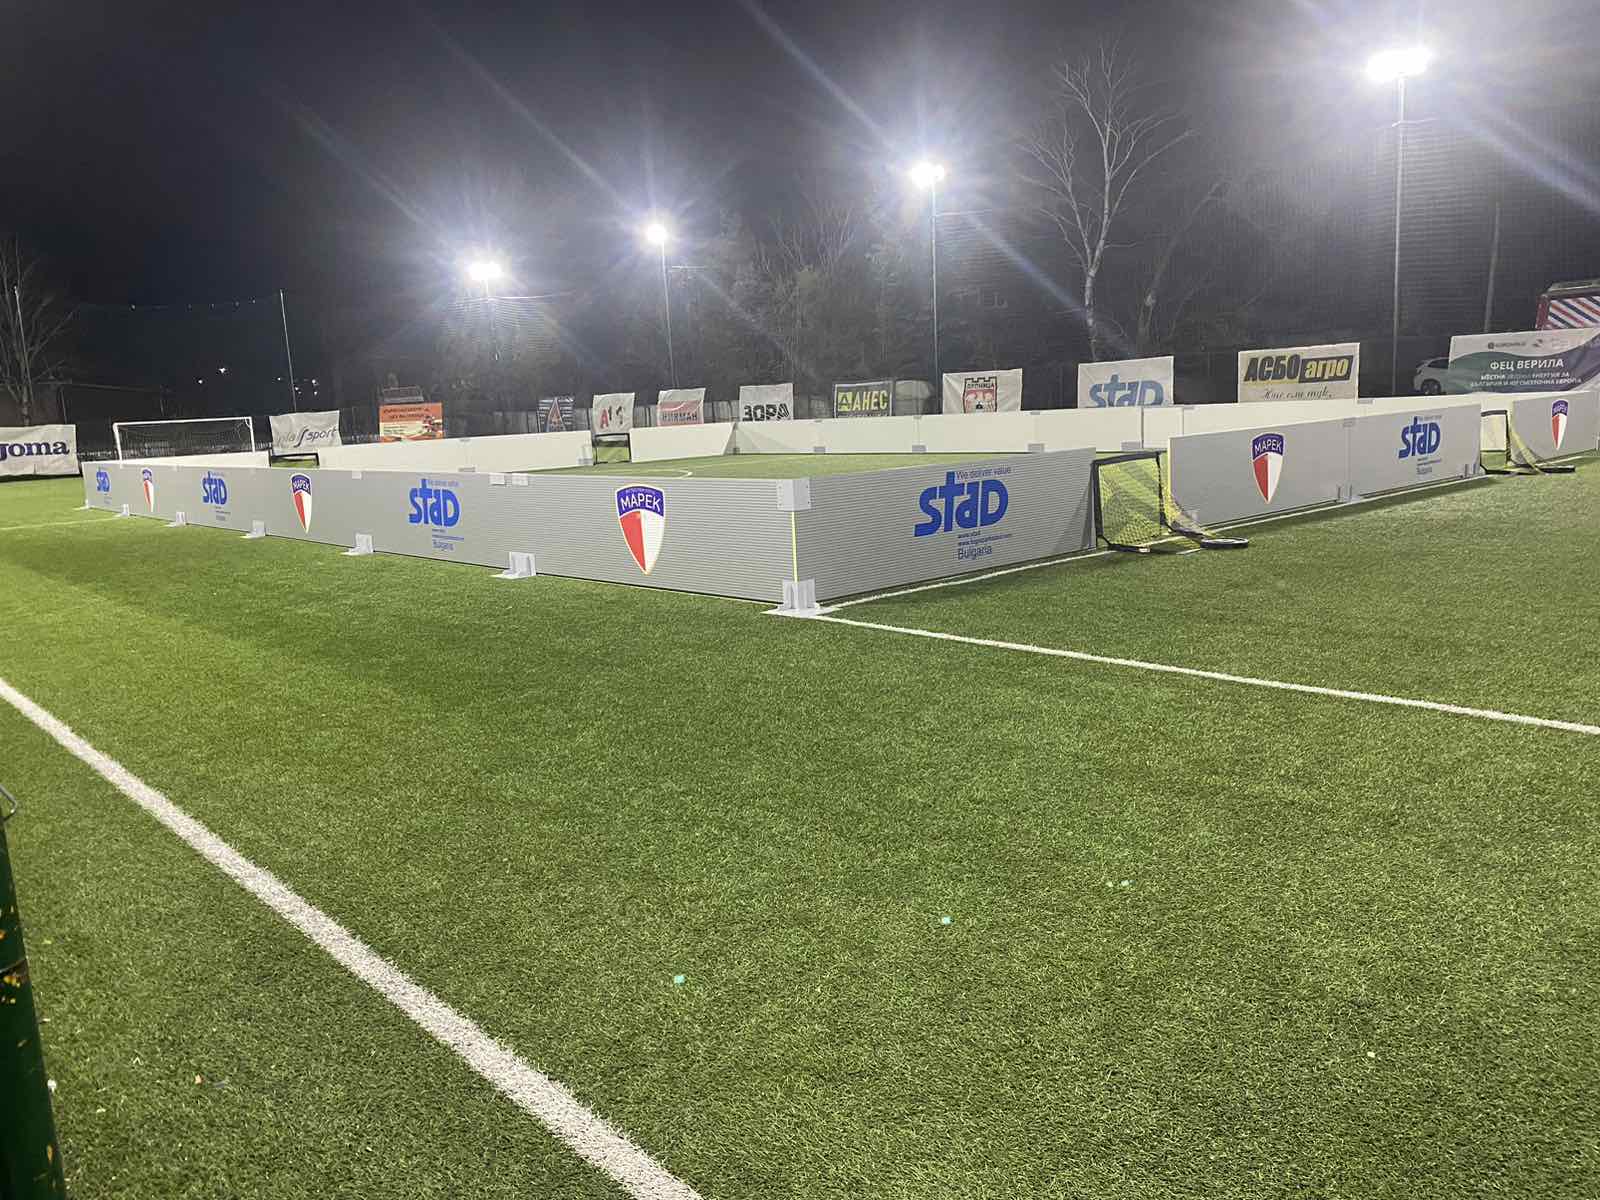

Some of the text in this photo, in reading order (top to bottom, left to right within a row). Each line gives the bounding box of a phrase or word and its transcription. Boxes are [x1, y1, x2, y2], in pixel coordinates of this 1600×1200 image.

[1244, 354, 1350, 382] АСБО агро
[1490, 358, 1564, 371] ФЕЦ ВЕРИЛА
[1254, 439, 1282, 455] МАРЕК
[293, 479, 310, 493] МАРЕК
[620, 492, 661, 512] МАРЕК
